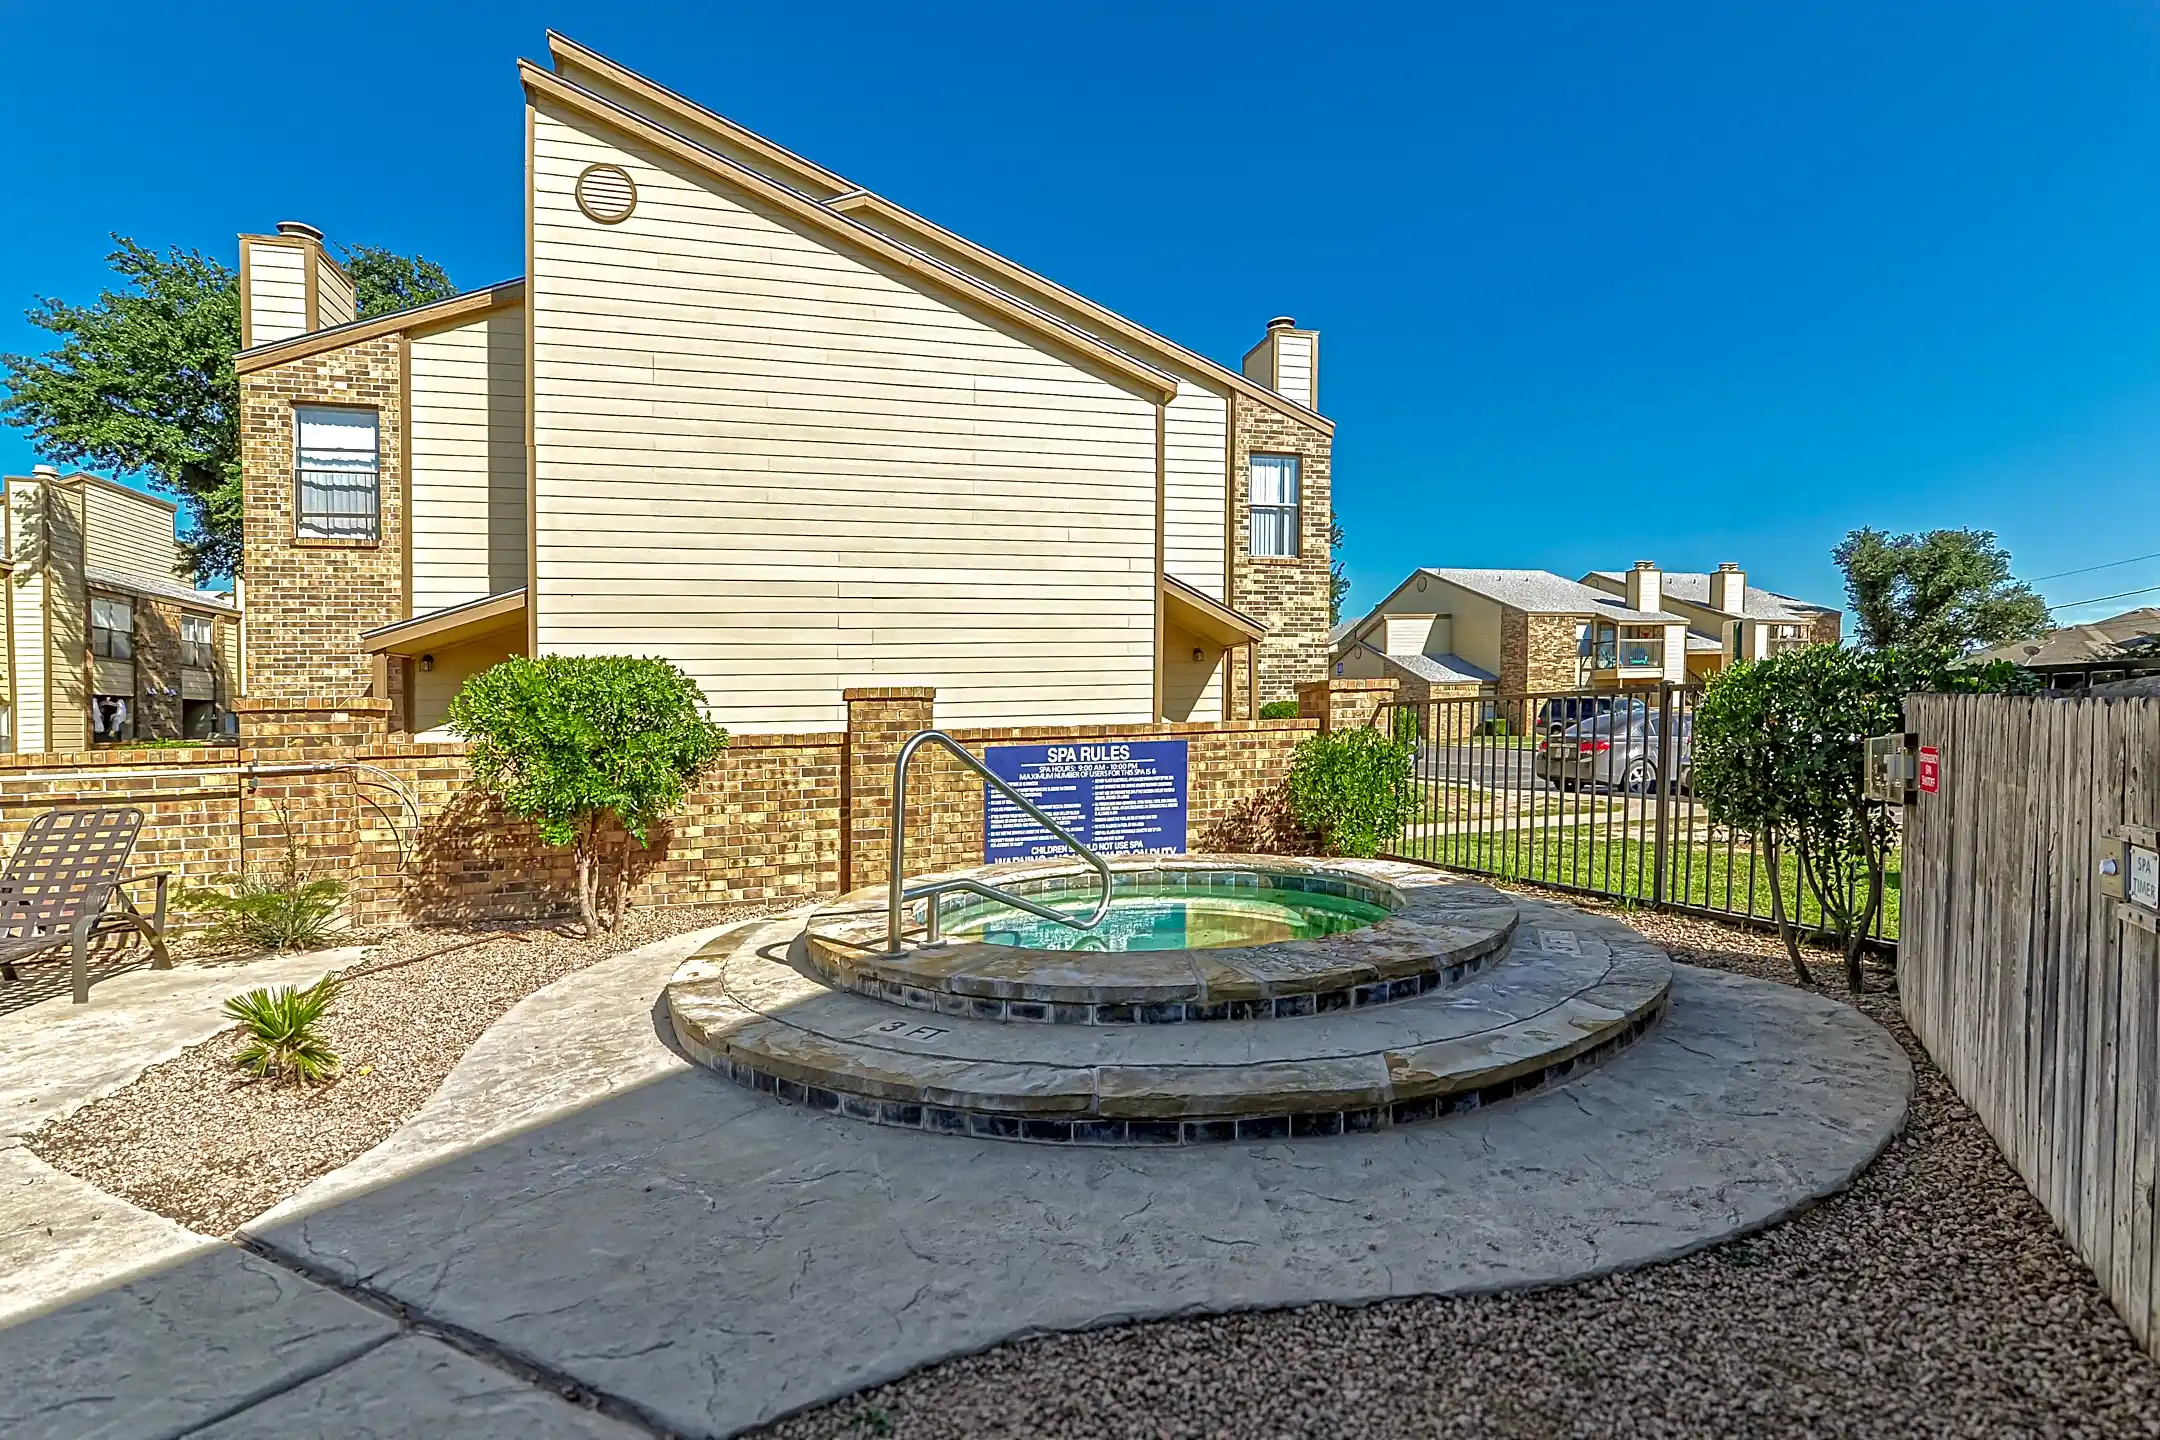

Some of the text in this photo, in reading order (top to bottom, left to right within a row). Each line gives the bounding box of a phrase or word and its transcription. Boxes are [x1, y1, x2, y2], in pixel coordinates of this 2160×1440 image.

[1047, 745, 1130, 763] SPA RULES
[1019, 772, 1054, 780] MAXIMUM
[1054, 771, 1080, 779] NUMBER
[1108, 769, 1121, 777] FOR
[1134, 768, 1146, 776] SPA
[1151, 767, 1157, 775] 6
[1052, 765, 1076, 773] HOURS:
[1078, 764, 1092, 772] 9:00
[1031, 845, 1068, 855] CHILDREN
[1068, 842, 1098, 853] SULD
[1098, 841, 1114, 851] NOT
[1114, 840, 1129, 850] USE
[1129, 839, 1144, 849] SPA
[2138, 857, 2151, 874] SPA
[2133, 876, 2156, 899] TIMER
[879, 1021, 950, 1040] 3 FT
